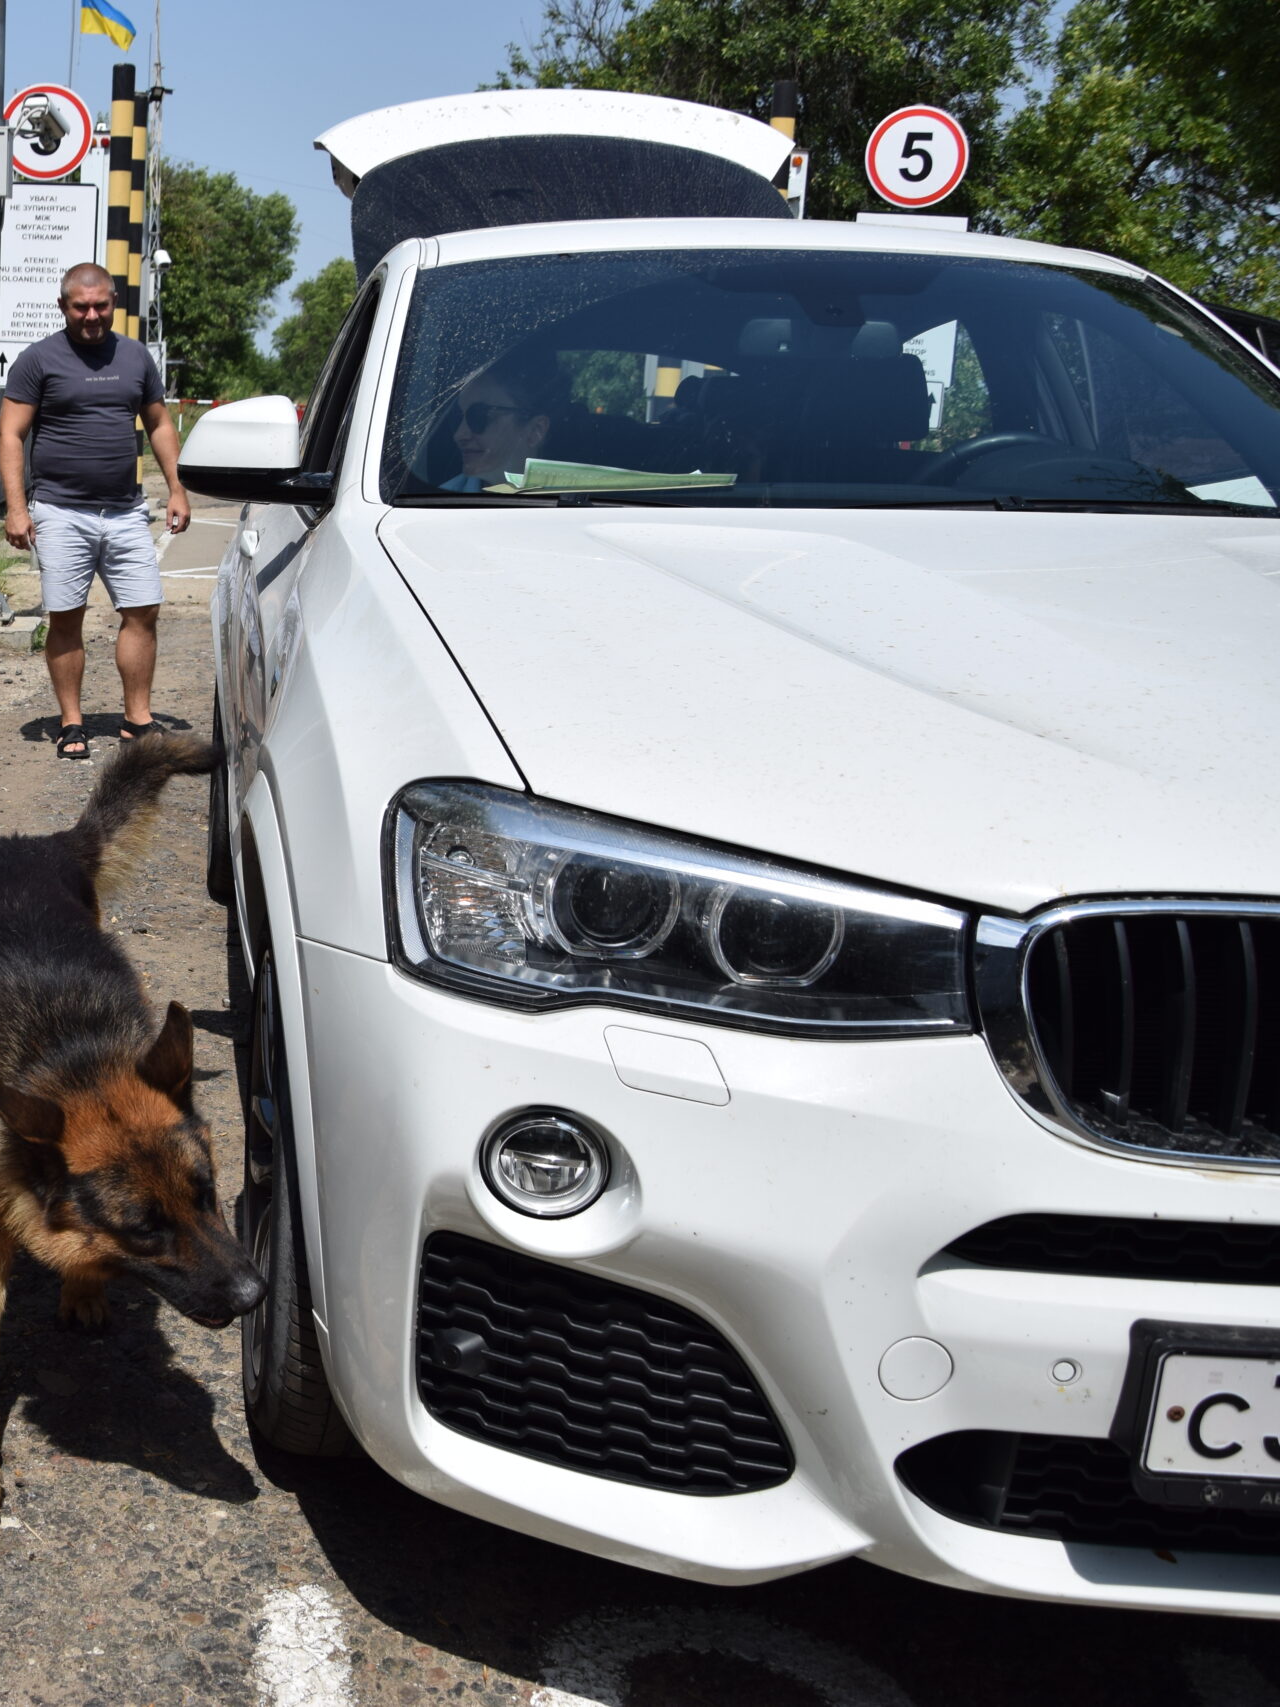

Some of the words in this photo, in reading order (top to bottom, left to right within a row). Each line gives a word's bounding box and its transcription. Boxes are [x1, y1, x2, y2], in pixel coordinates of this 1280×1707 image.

[898, 132, 933, 182] 5
[23, 204, 77, 212] ЗУПИНЯТИСЯ
[15, 223, 70, 231] СМУГАСТИМИ
[1, 275, 45, 283] OLOANELE
